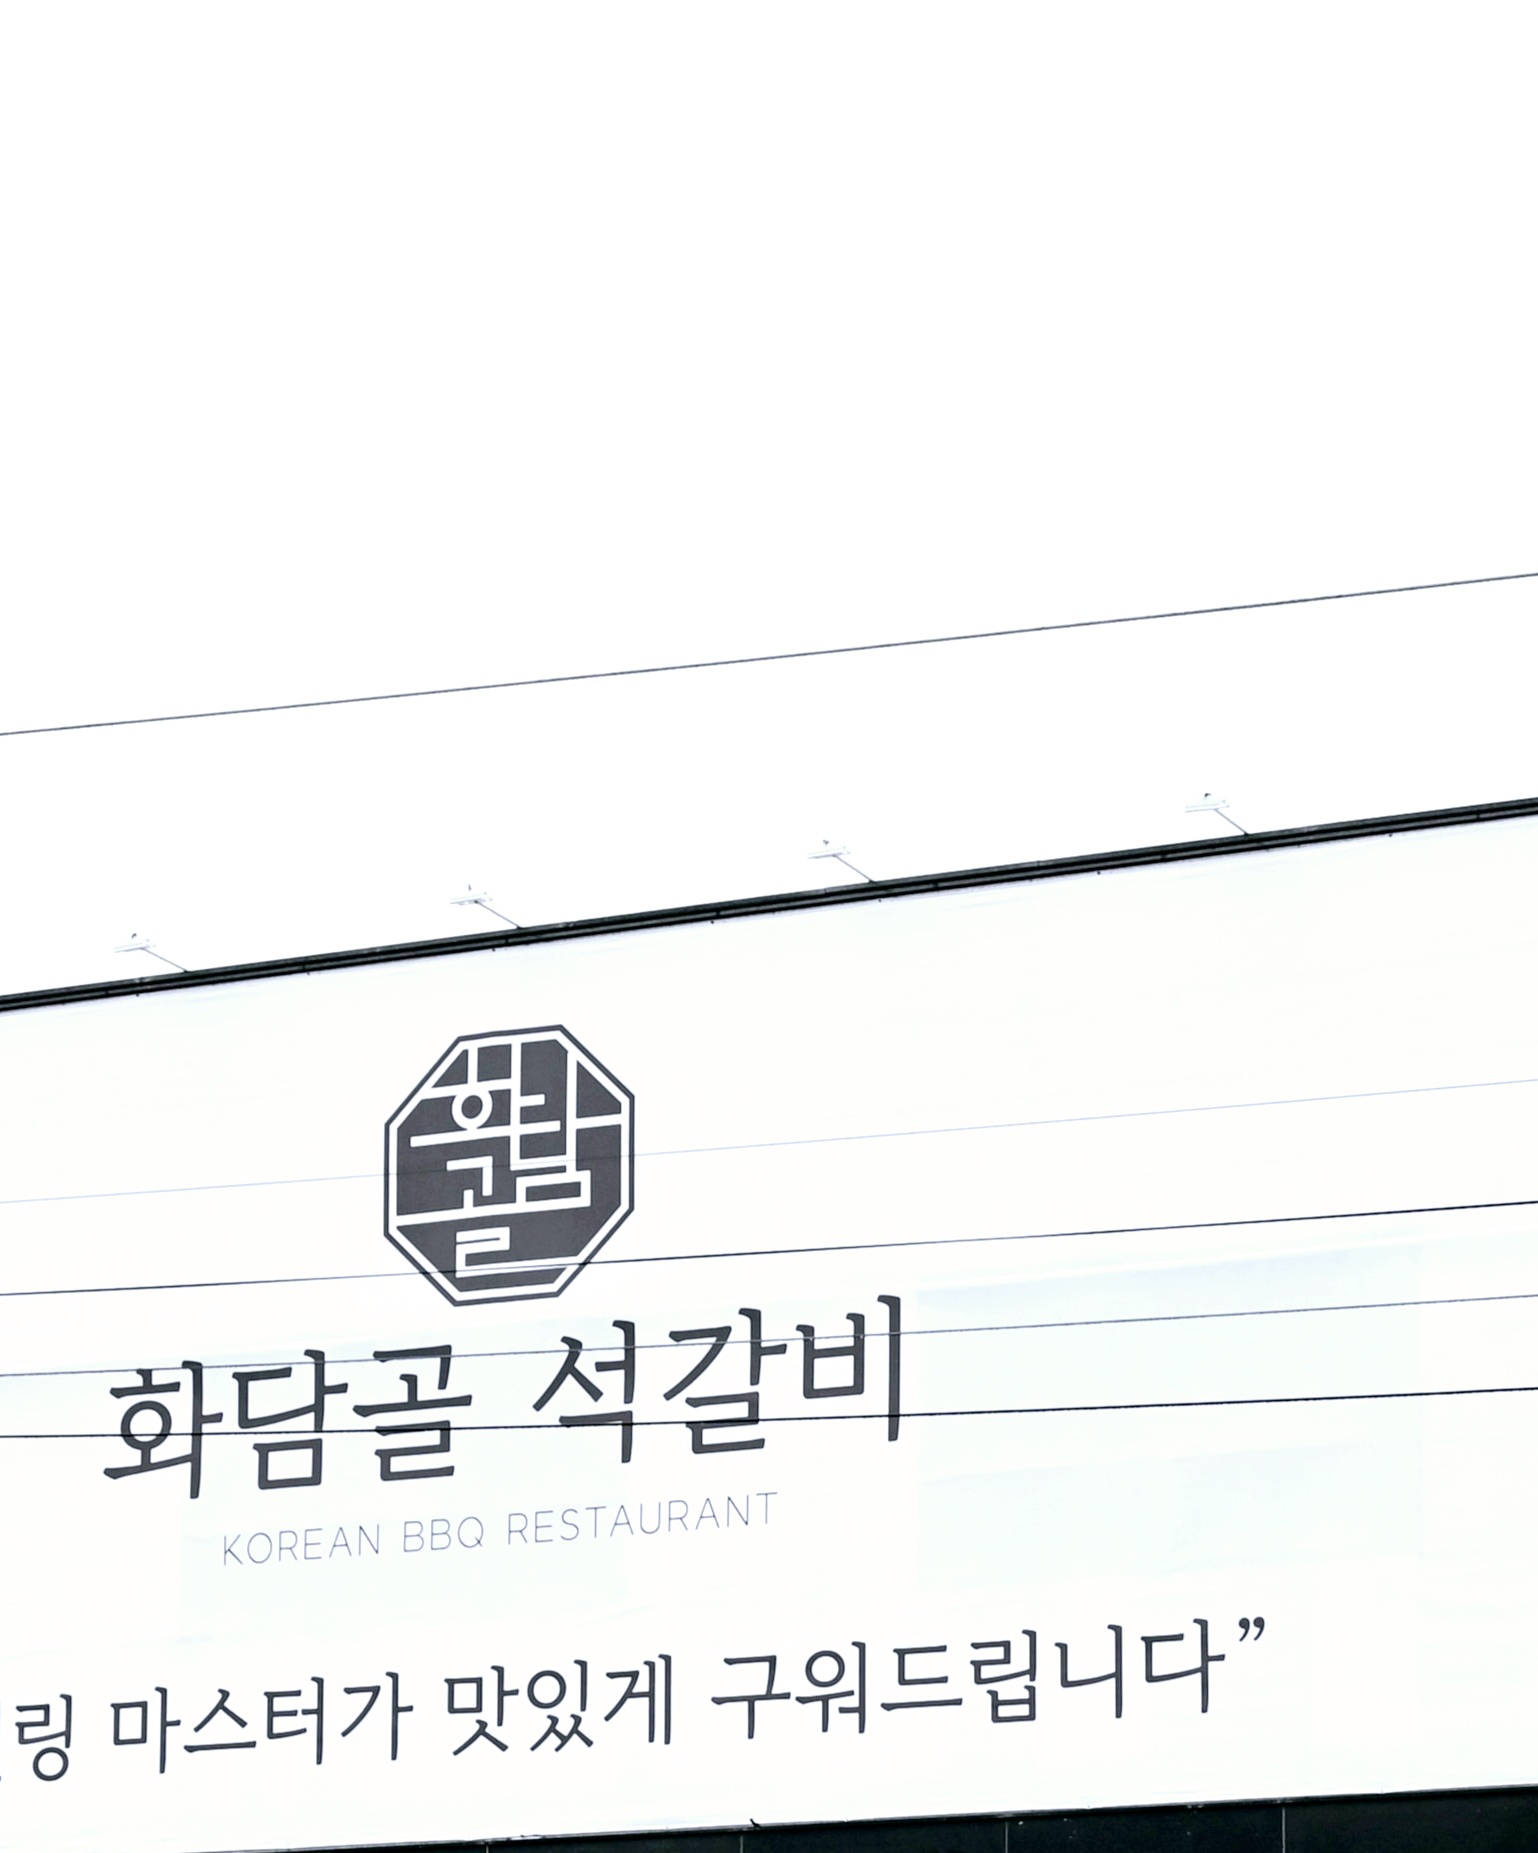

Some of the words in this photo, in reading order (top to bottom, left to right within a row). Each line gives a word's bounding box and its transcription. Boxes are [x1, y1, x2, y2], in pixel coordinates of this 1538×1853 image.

[103, 1345, 474, 1500] 화담골
[531, 1294, 904, 1465] 석갈비
[222, 1523, 381, 1566] KOREAN
[403, 1515, 485, 1554] BBQ
[507, 1491, 779, 1545] RESTAURANT
[110, 1671, 415, 1774] 마스터가
[444, 1654, 673, 1756] 맛있게
